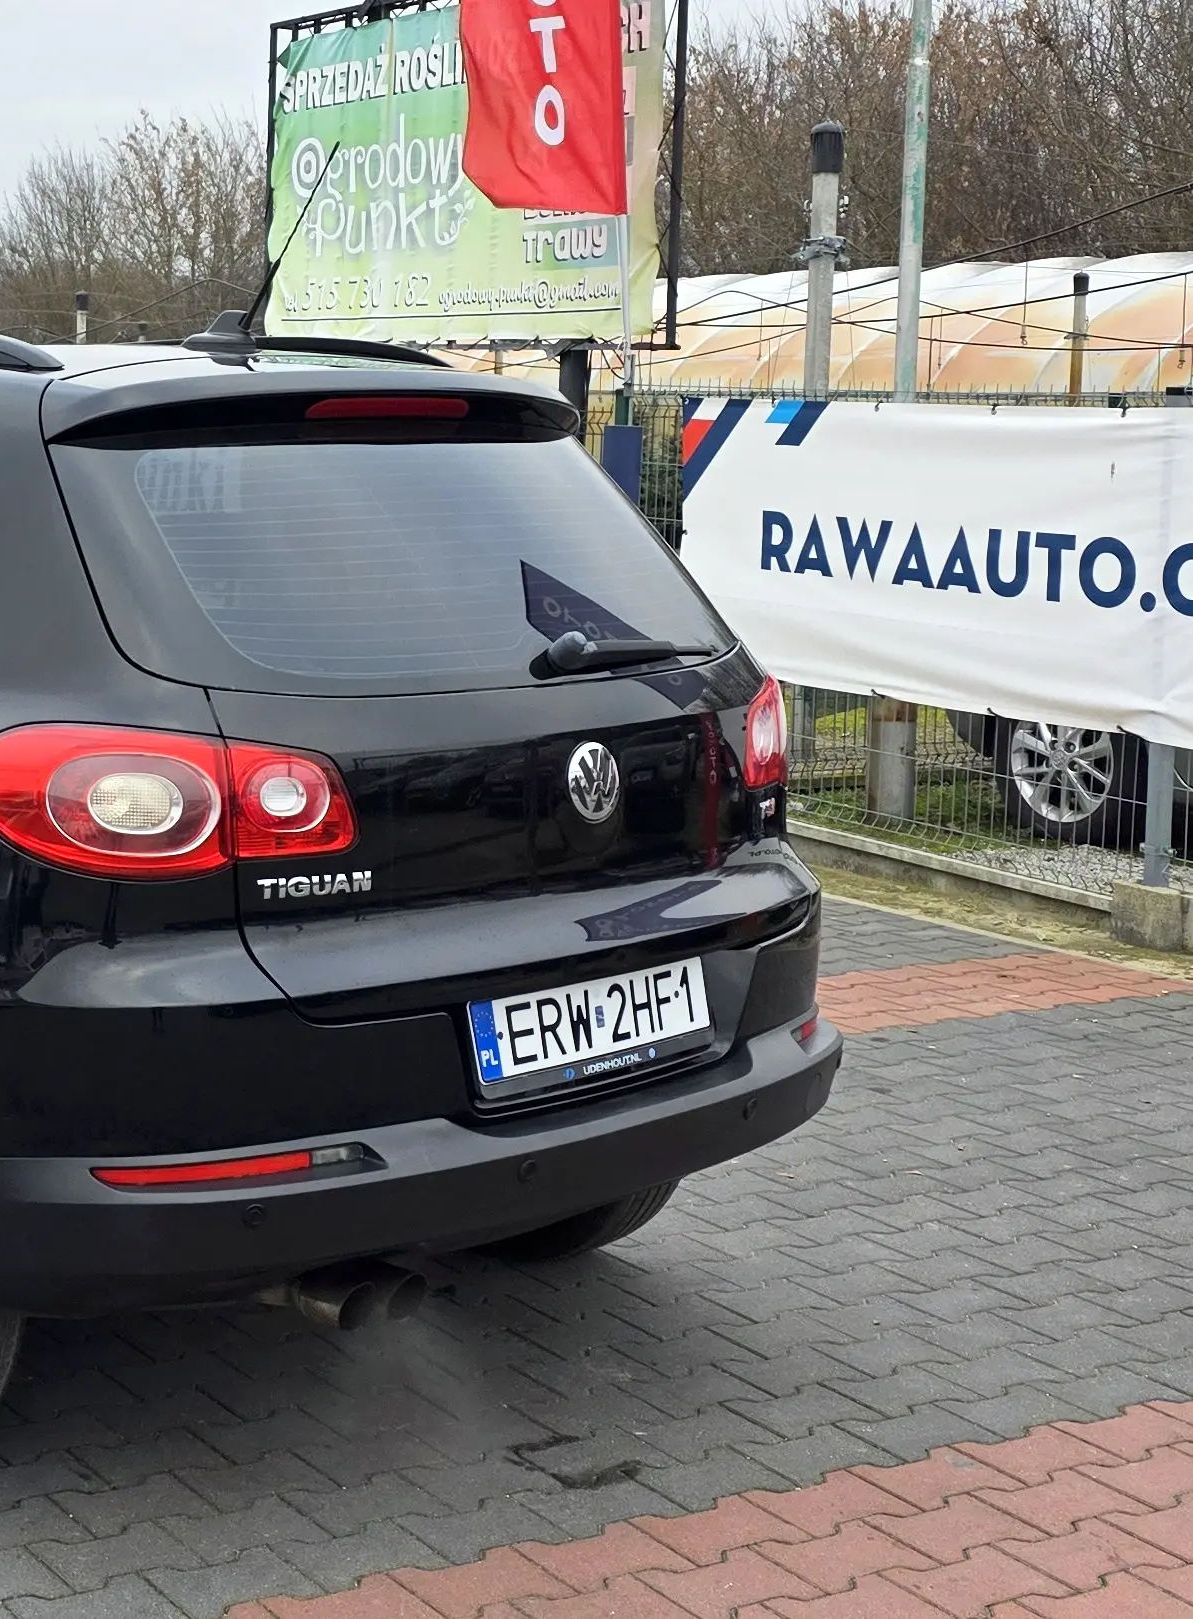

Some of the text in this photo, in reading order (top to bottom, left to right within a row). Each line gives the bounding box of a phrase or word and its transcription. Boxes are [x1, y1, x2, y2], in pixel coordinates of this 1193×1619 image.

[280, 32, 466, 114] SPRZEDAŻ ROŚLI
[302, 276, 342, 311] 515
[348, 275, 383, 309] 730
[394, 272, 433, 308] 182
[438, 274, 621, 312] ogrodowy.punkt@gmail.com
[256, 870, 372, 900] TIGUAN
[505, 966, 696, 1066] ERW 2HF1
[480, 1050, 499, 1069] PL
